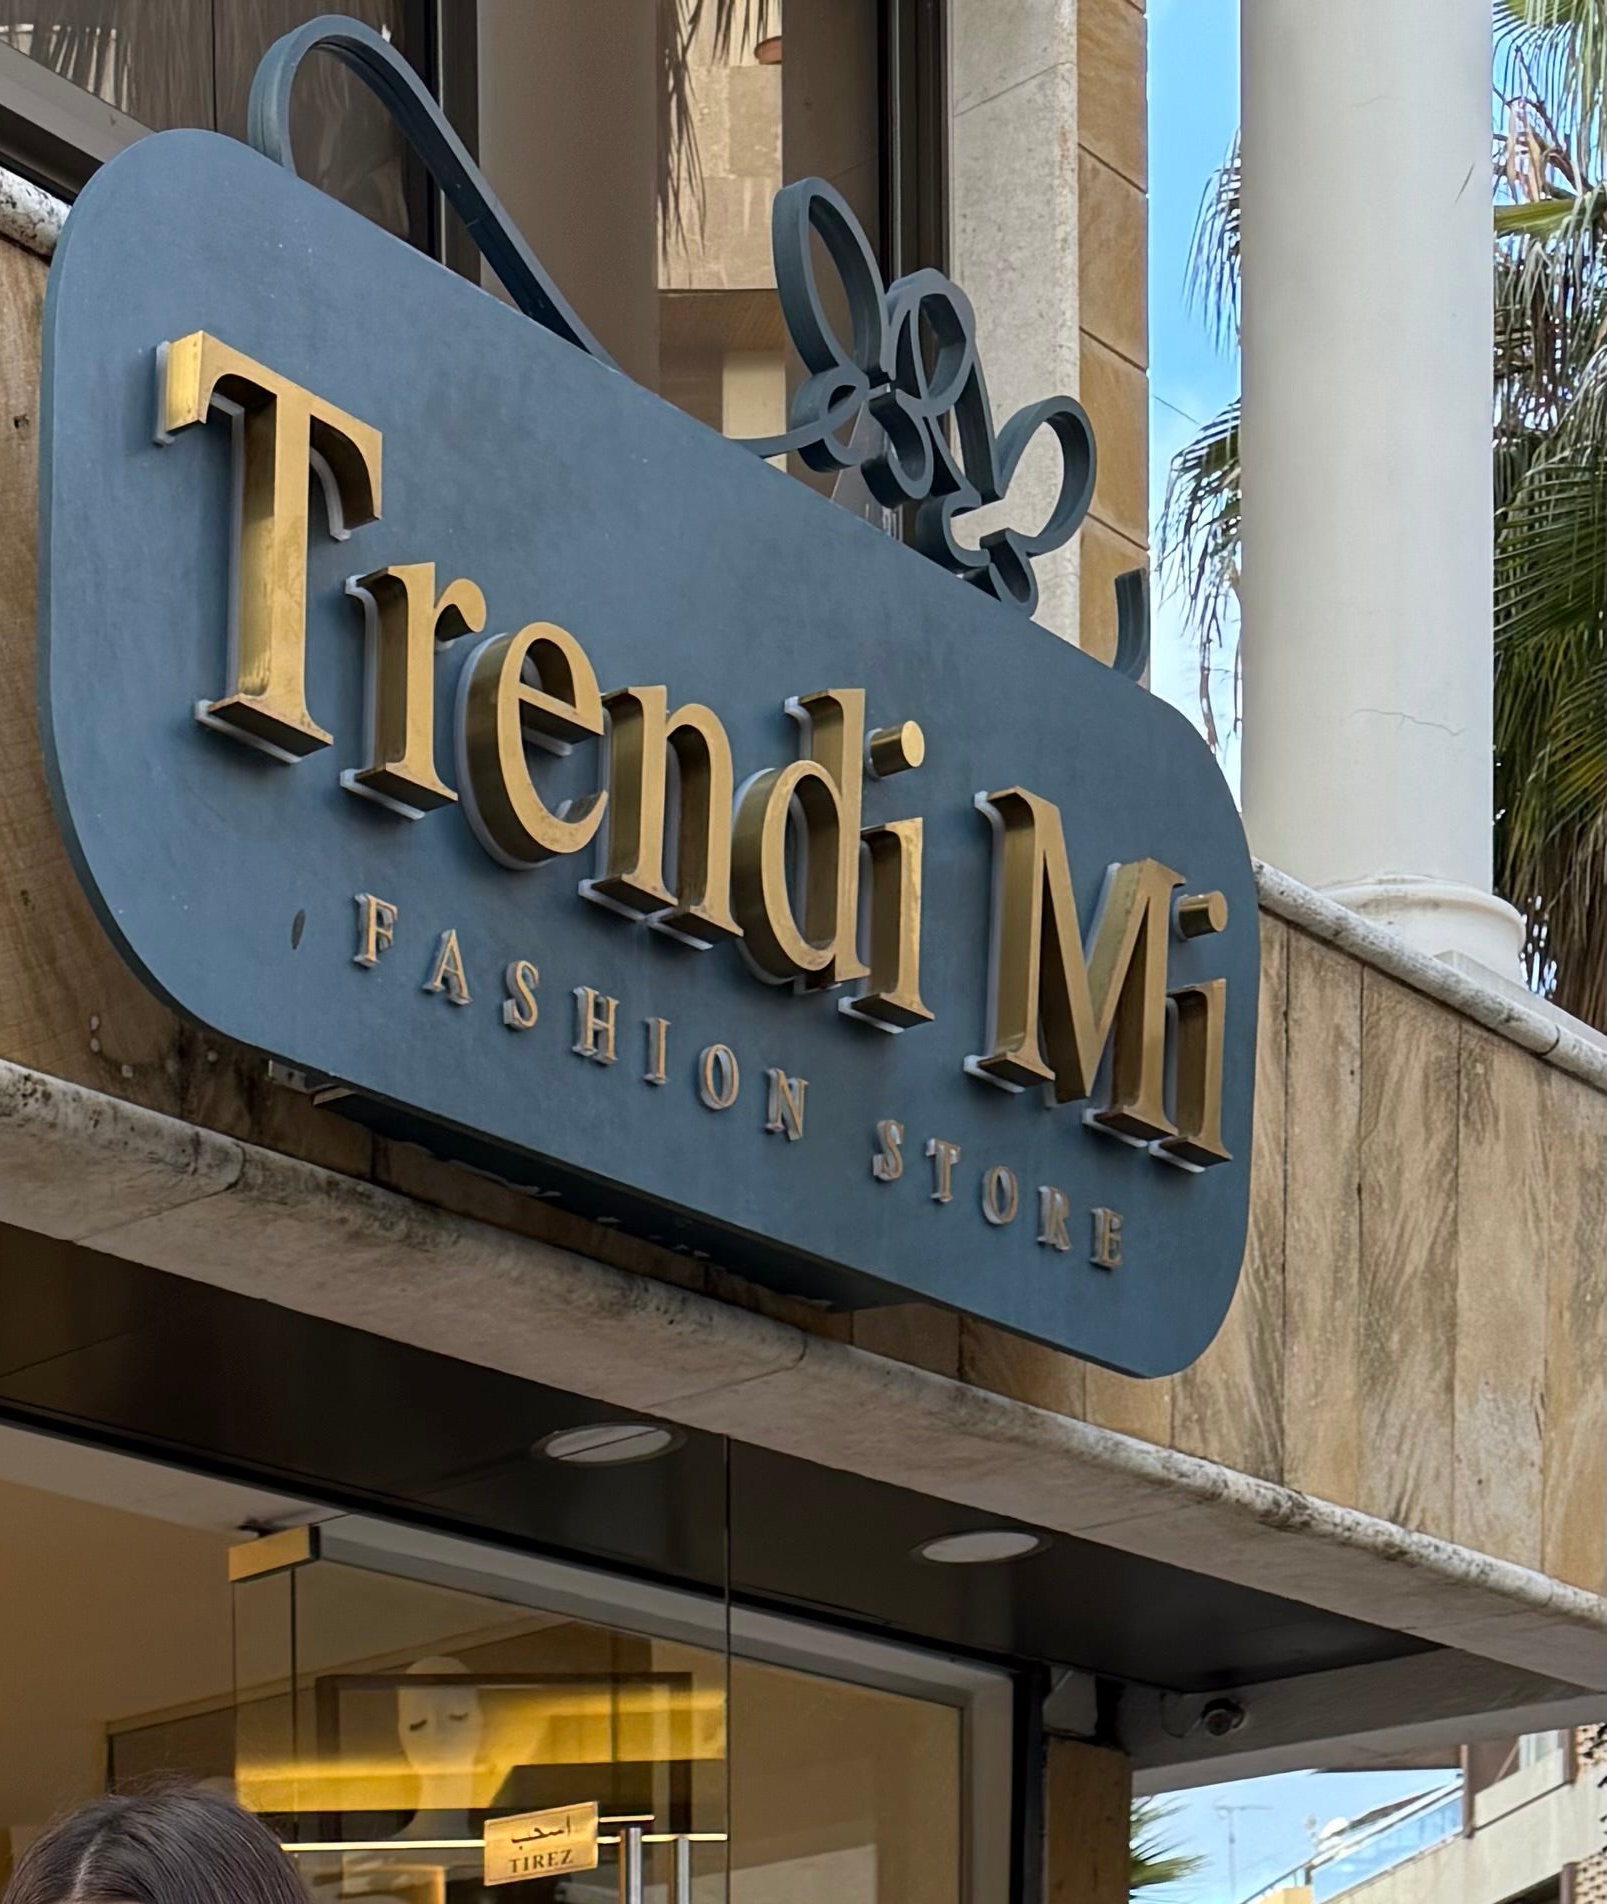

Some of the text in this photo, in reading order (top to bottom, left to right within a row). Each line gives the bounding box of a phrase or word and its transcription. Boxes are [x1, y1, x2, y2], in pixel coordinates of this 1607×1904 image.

[154, 330, 1233, 1172] Trendi Mi
[353, 892, 1124, 1269] FASHION STORE
[509, 1848, 573, 1873] TIREZ
[511, 1814, 572, 1850] اسحب
